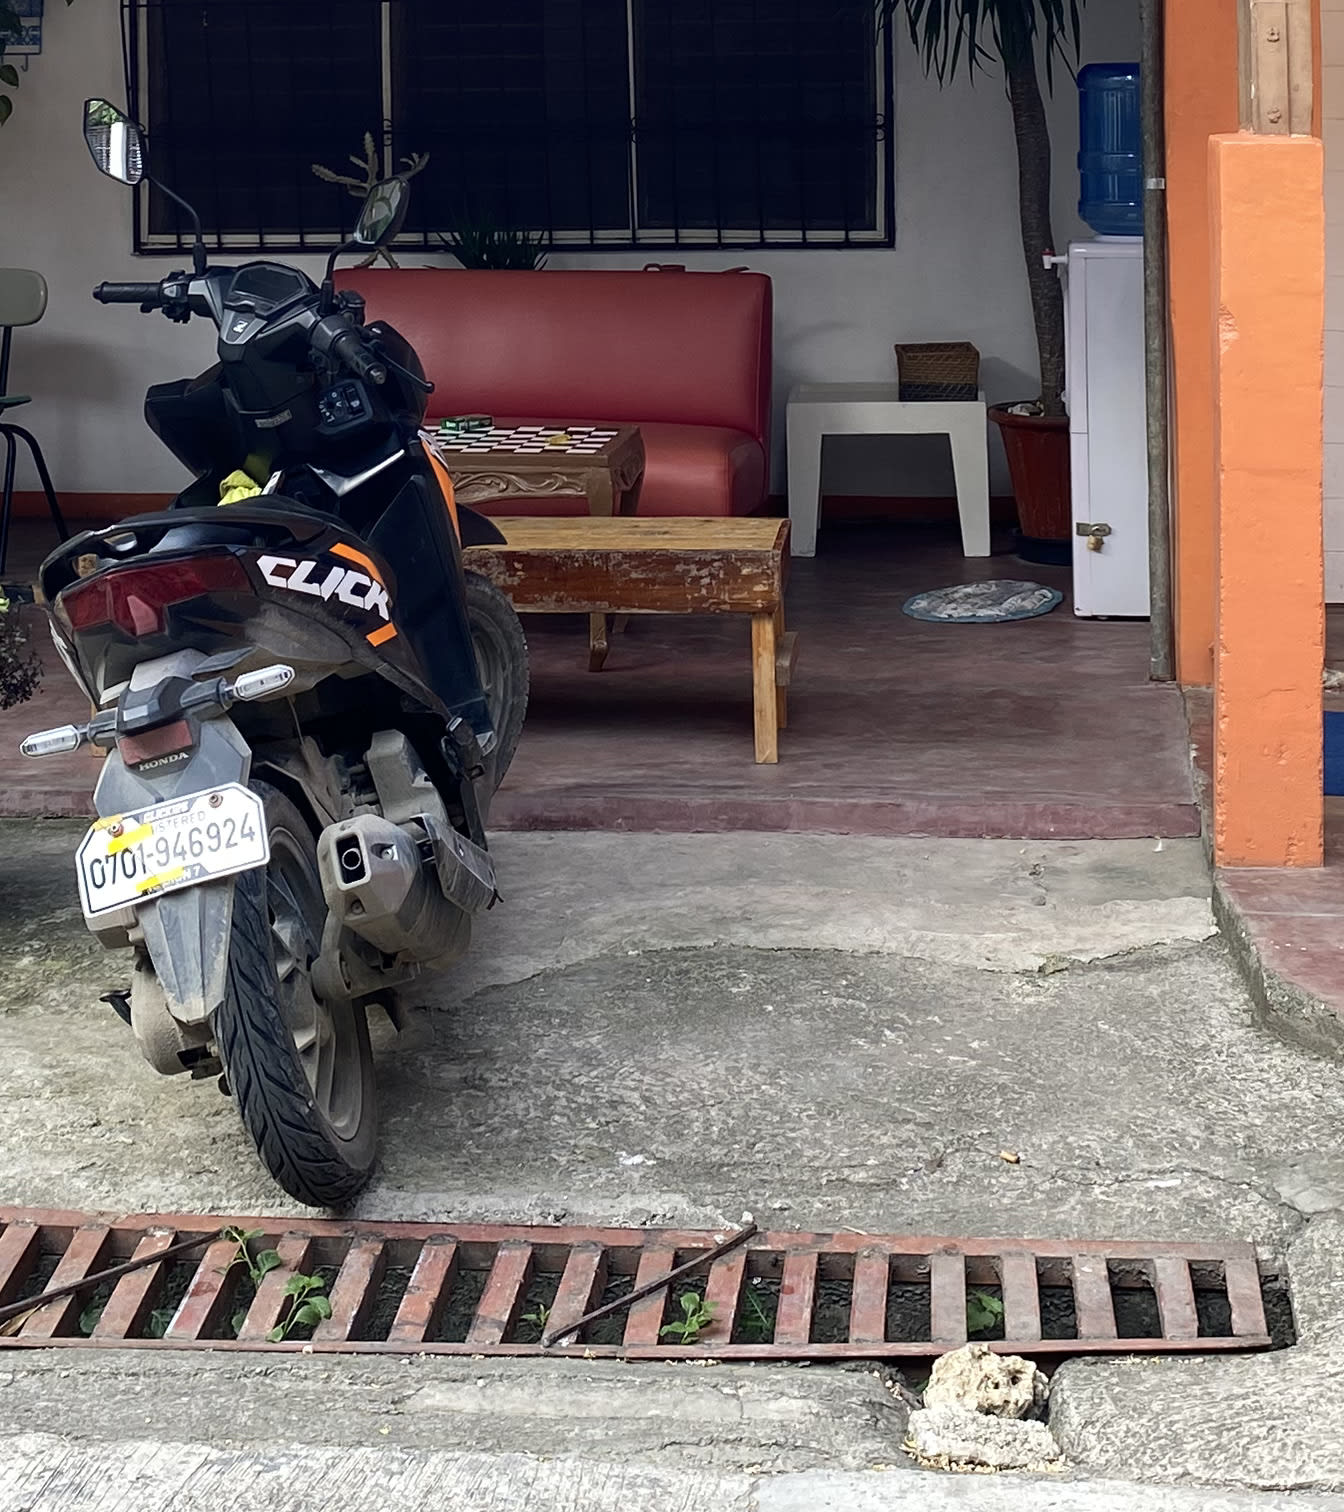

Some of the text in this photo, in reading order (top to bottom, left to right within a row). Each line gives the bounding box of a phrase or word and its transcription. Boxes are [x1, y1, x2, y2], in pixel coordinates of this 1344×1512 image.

[256, 555, 389, 621] CLICK
[139, 752, 189, 771] HONDA
[89, 812, 255, 890] 0701-946924
